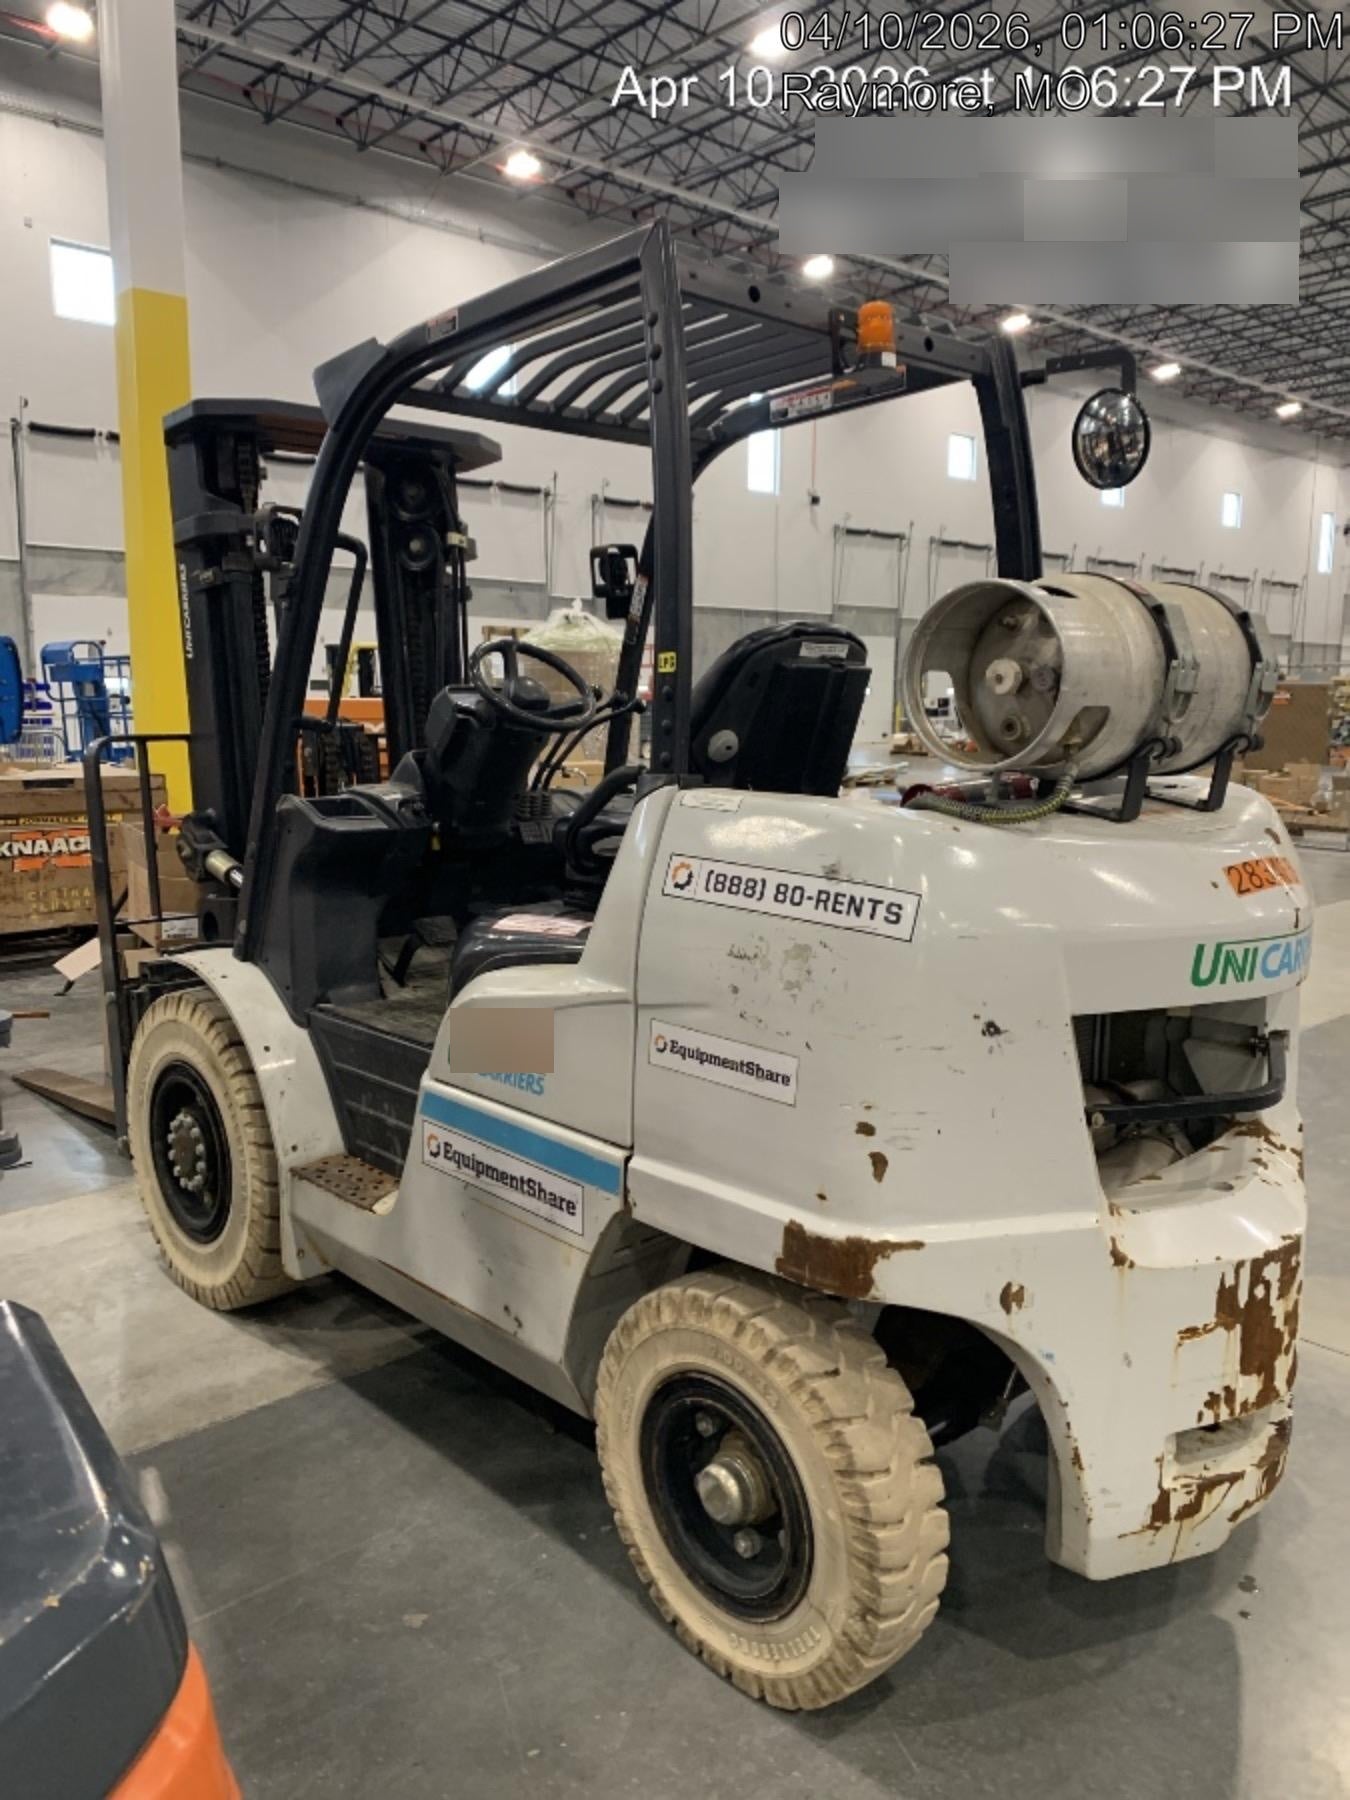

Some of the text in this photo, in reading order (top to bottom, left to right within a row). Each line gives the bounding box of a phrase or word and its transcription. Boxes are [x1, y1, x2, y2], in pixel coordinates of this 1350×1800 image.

[0, 837, 91, 857] KNAAC
[704, 869, 904, 925] (888) 80-RENTS
[669, 1039, 791, 1087] EquipmentShare
[443, 1141, 577, 1217] EquipmentShare
